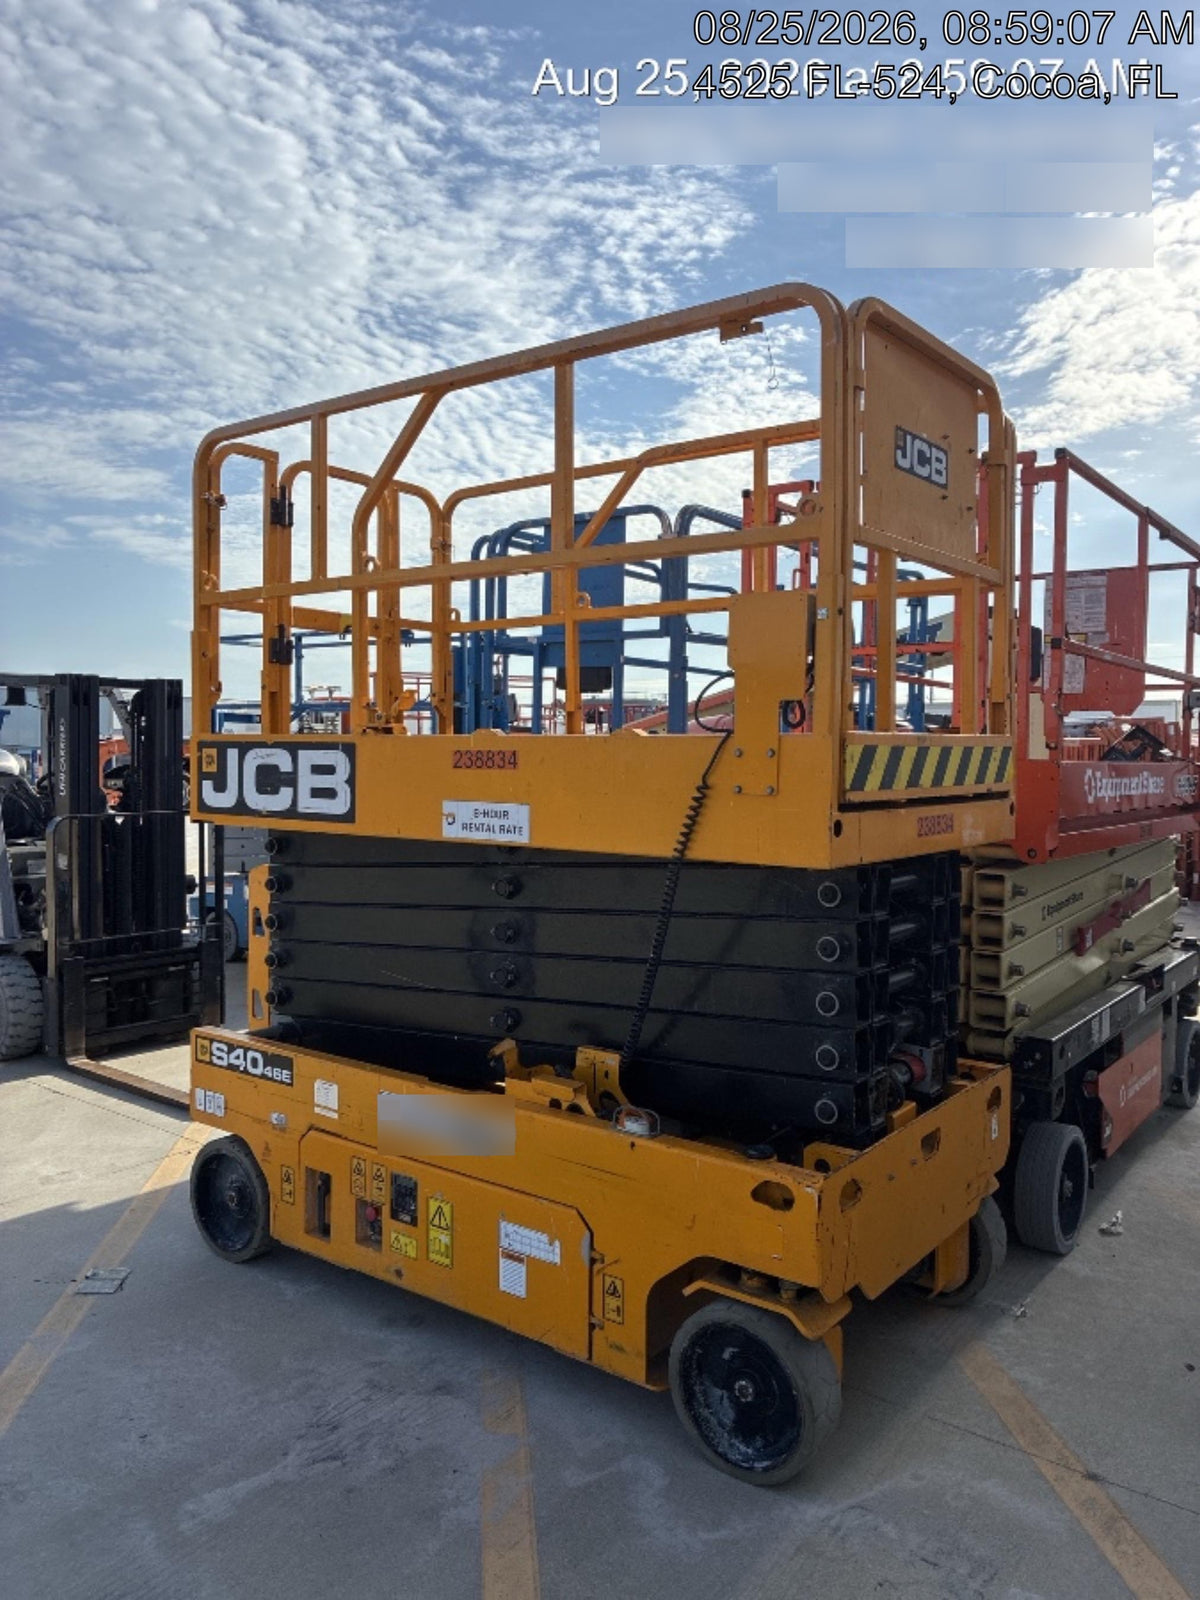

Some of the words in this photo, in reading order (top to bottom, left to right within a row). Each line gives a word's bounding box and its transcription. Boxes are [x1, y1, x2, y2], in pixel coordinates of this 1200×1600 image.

[895, 433, 948, 485] JCB
[452, 749, 518, 769] 238834
[201, 747, 352, 815] JCB
[461, 822, 497, 835] RENTAL
[498, 824, 524, 836] RATE
